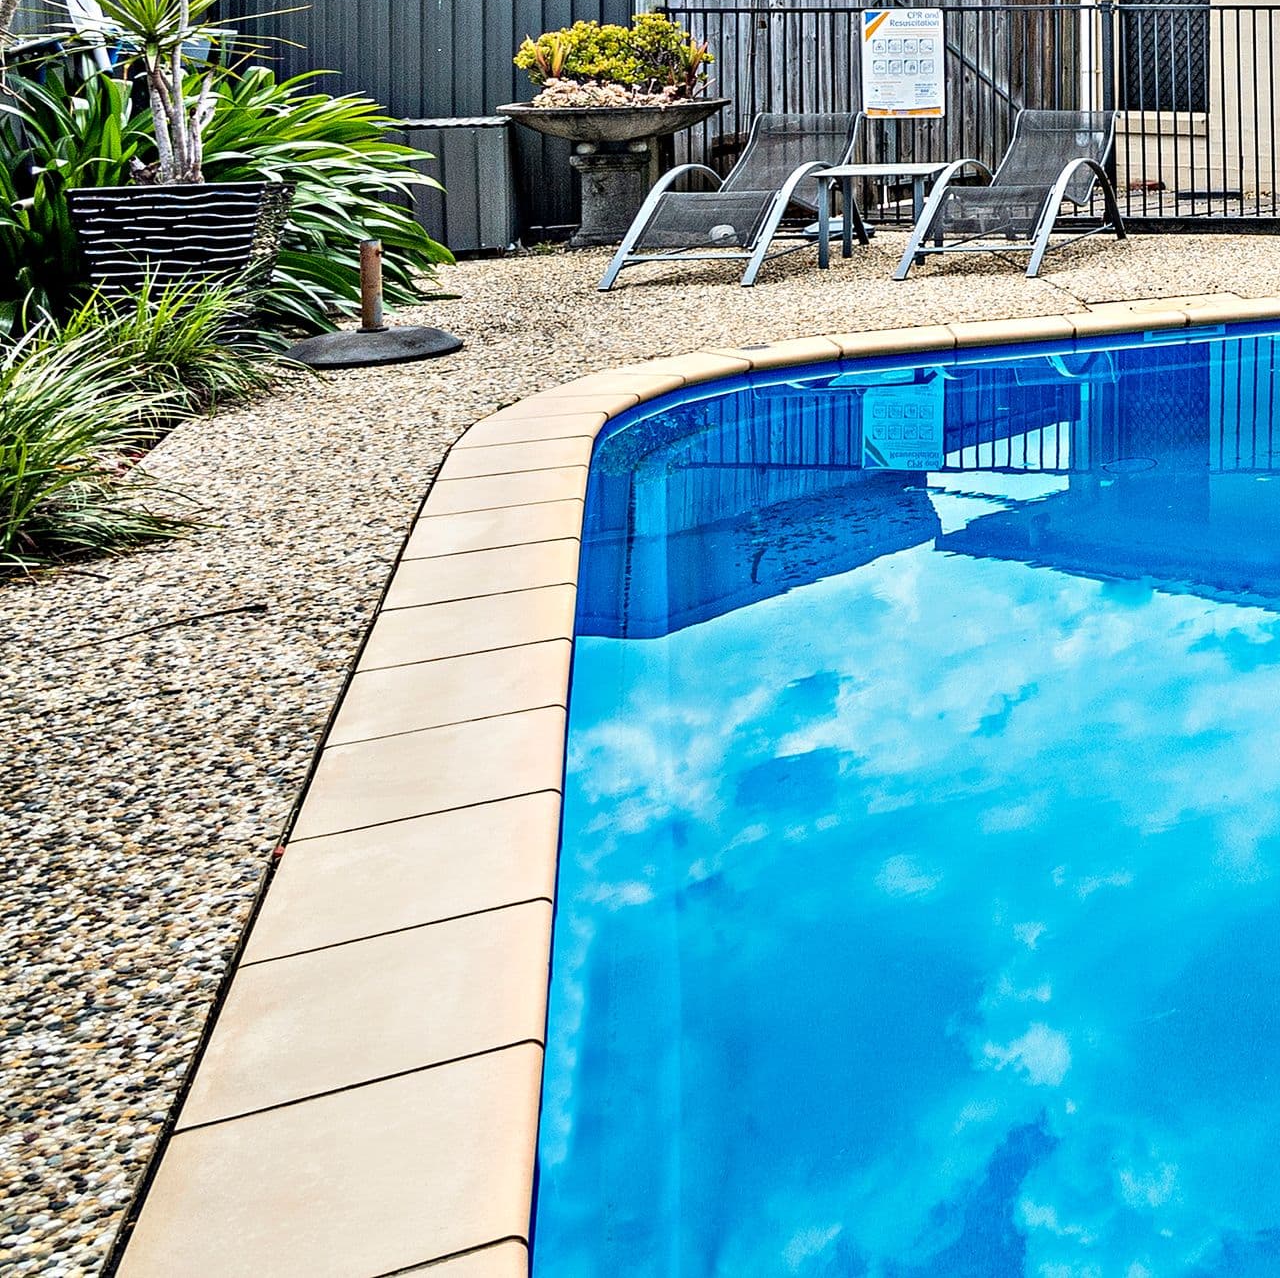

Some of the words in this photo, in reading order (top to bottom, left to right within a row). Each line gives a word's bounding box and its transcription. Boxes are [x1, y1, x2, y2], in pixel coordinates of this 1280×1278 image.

[907, 11, 923, 19] CPR
[925, 11, 939, 19] and
[890, 19, 939, 27] Resuscitation
